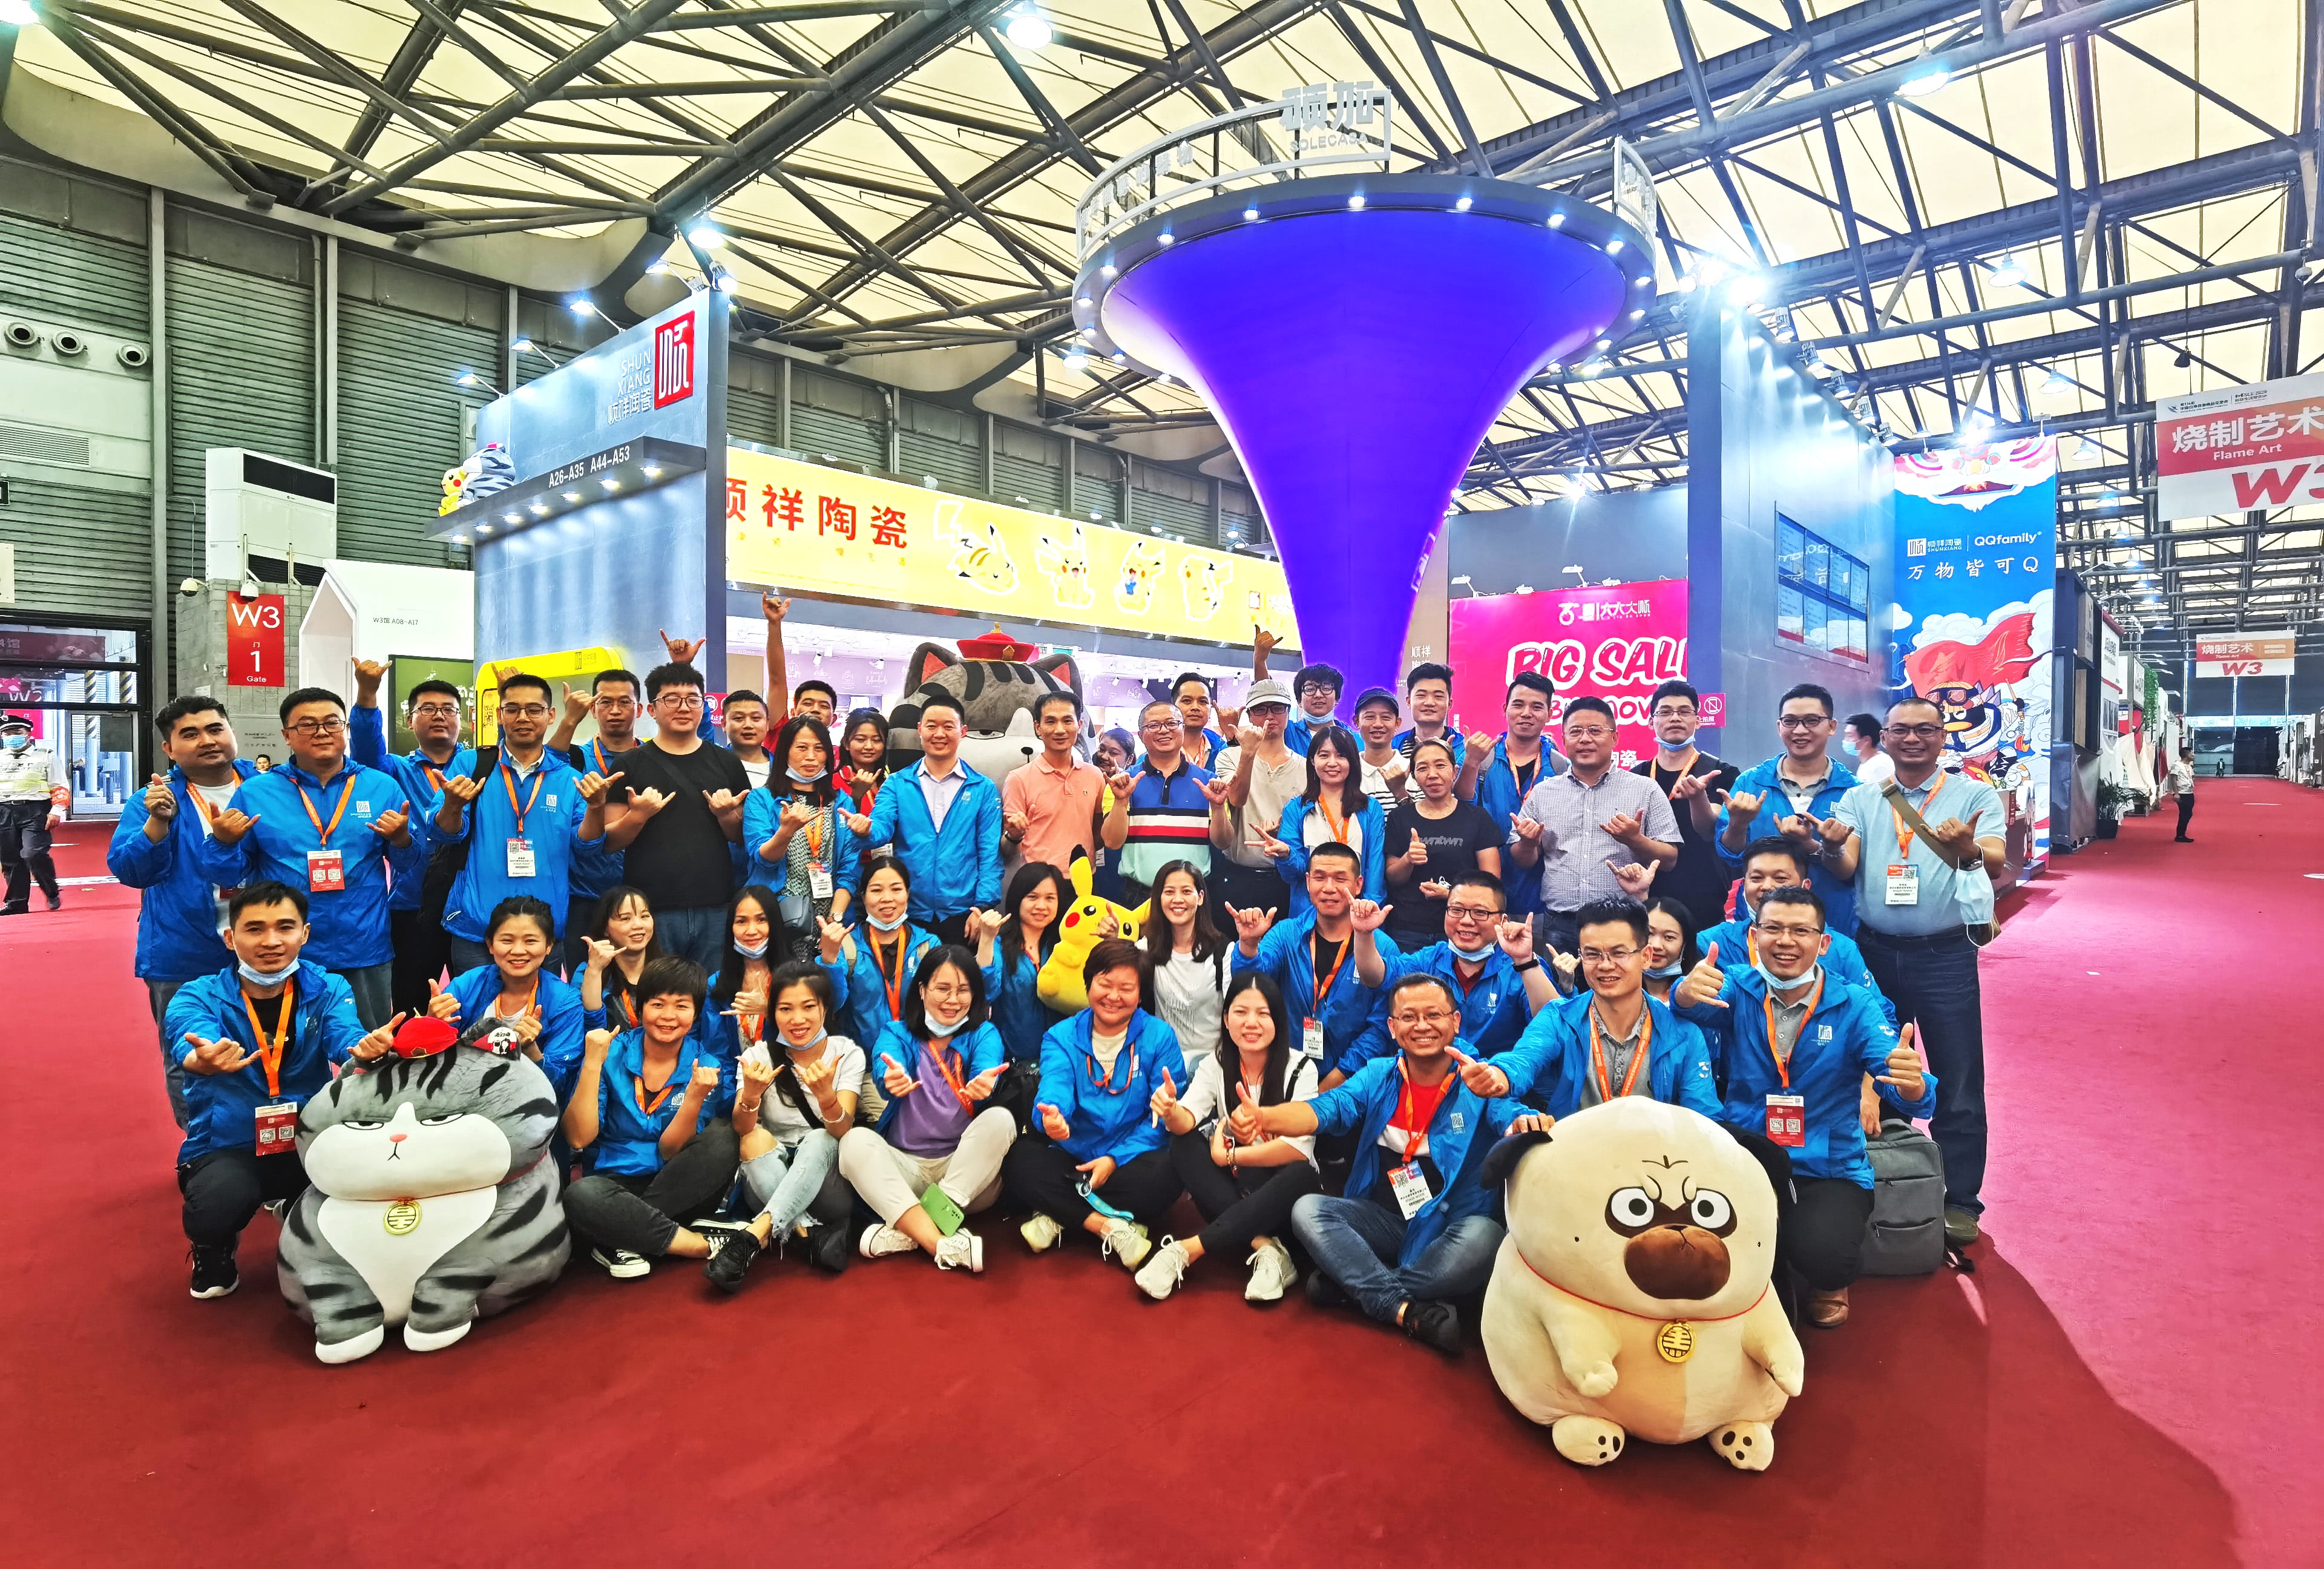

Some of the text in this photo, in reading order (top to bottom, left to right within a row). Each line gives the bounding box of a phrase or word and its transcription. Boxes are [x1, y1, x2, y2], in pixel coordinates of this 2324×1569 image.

[1290, 132, 1368, 153] SOLECASA
[621, 348, 652, 377] SHUN
[617, 368, 651, 396] XIANG
[608, 388, 652, 425] 顺祥陶瓷
[2172, 406, 2324, 453] 烧制艺术
[2213, 444, 2282, 461] Flame Art
[548, 446, 630, 488] A26-A35 A44-A53
[231, 603, 281, 629] W3
[250, 651, 261, 673] 1
[1411, 645, 1431, 658] 顺祥
[2202, 643, 2254, 655] 烧制艺术
[1506, 640, 1586, 689] BIG
[2222, 662, 2263, 676] W3
